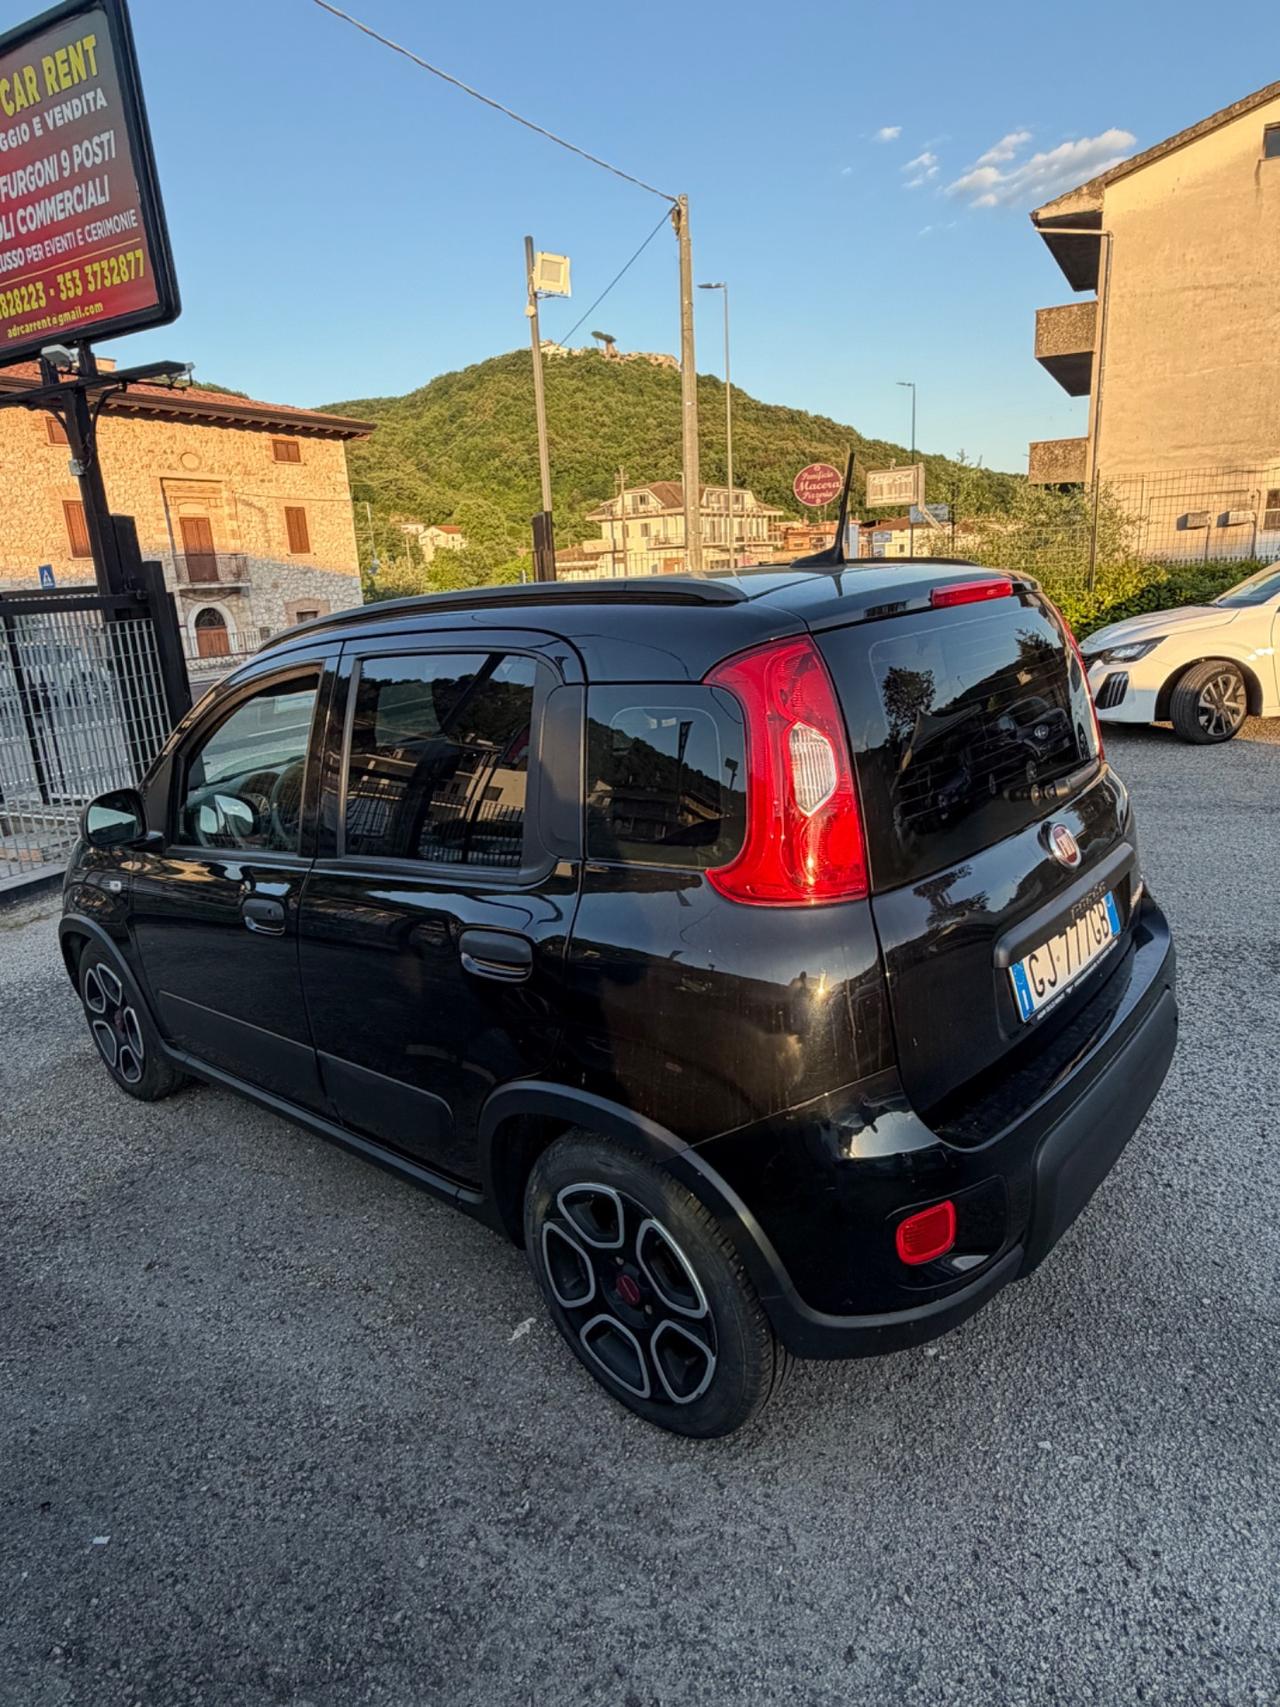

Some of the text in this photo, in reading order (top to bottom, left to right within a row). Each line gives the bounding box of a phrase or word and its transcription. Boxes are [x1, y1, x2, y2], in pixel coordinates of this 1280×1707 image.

[0, 34, 98, 117] CAR RENT
[32, 116, 43, 137] E
[44, 87, 108, 130] VENDITA
[0, 130, 116, 203] FURGONI 9 POSTI
[16, 174, 109, 234] COMMERCIALI
[0, 209, 138, 274] USSO PER EVENTI E CERIMONIE
[56, 268, 83, 301] 353
[84, 249, 145, 292] 3732877
